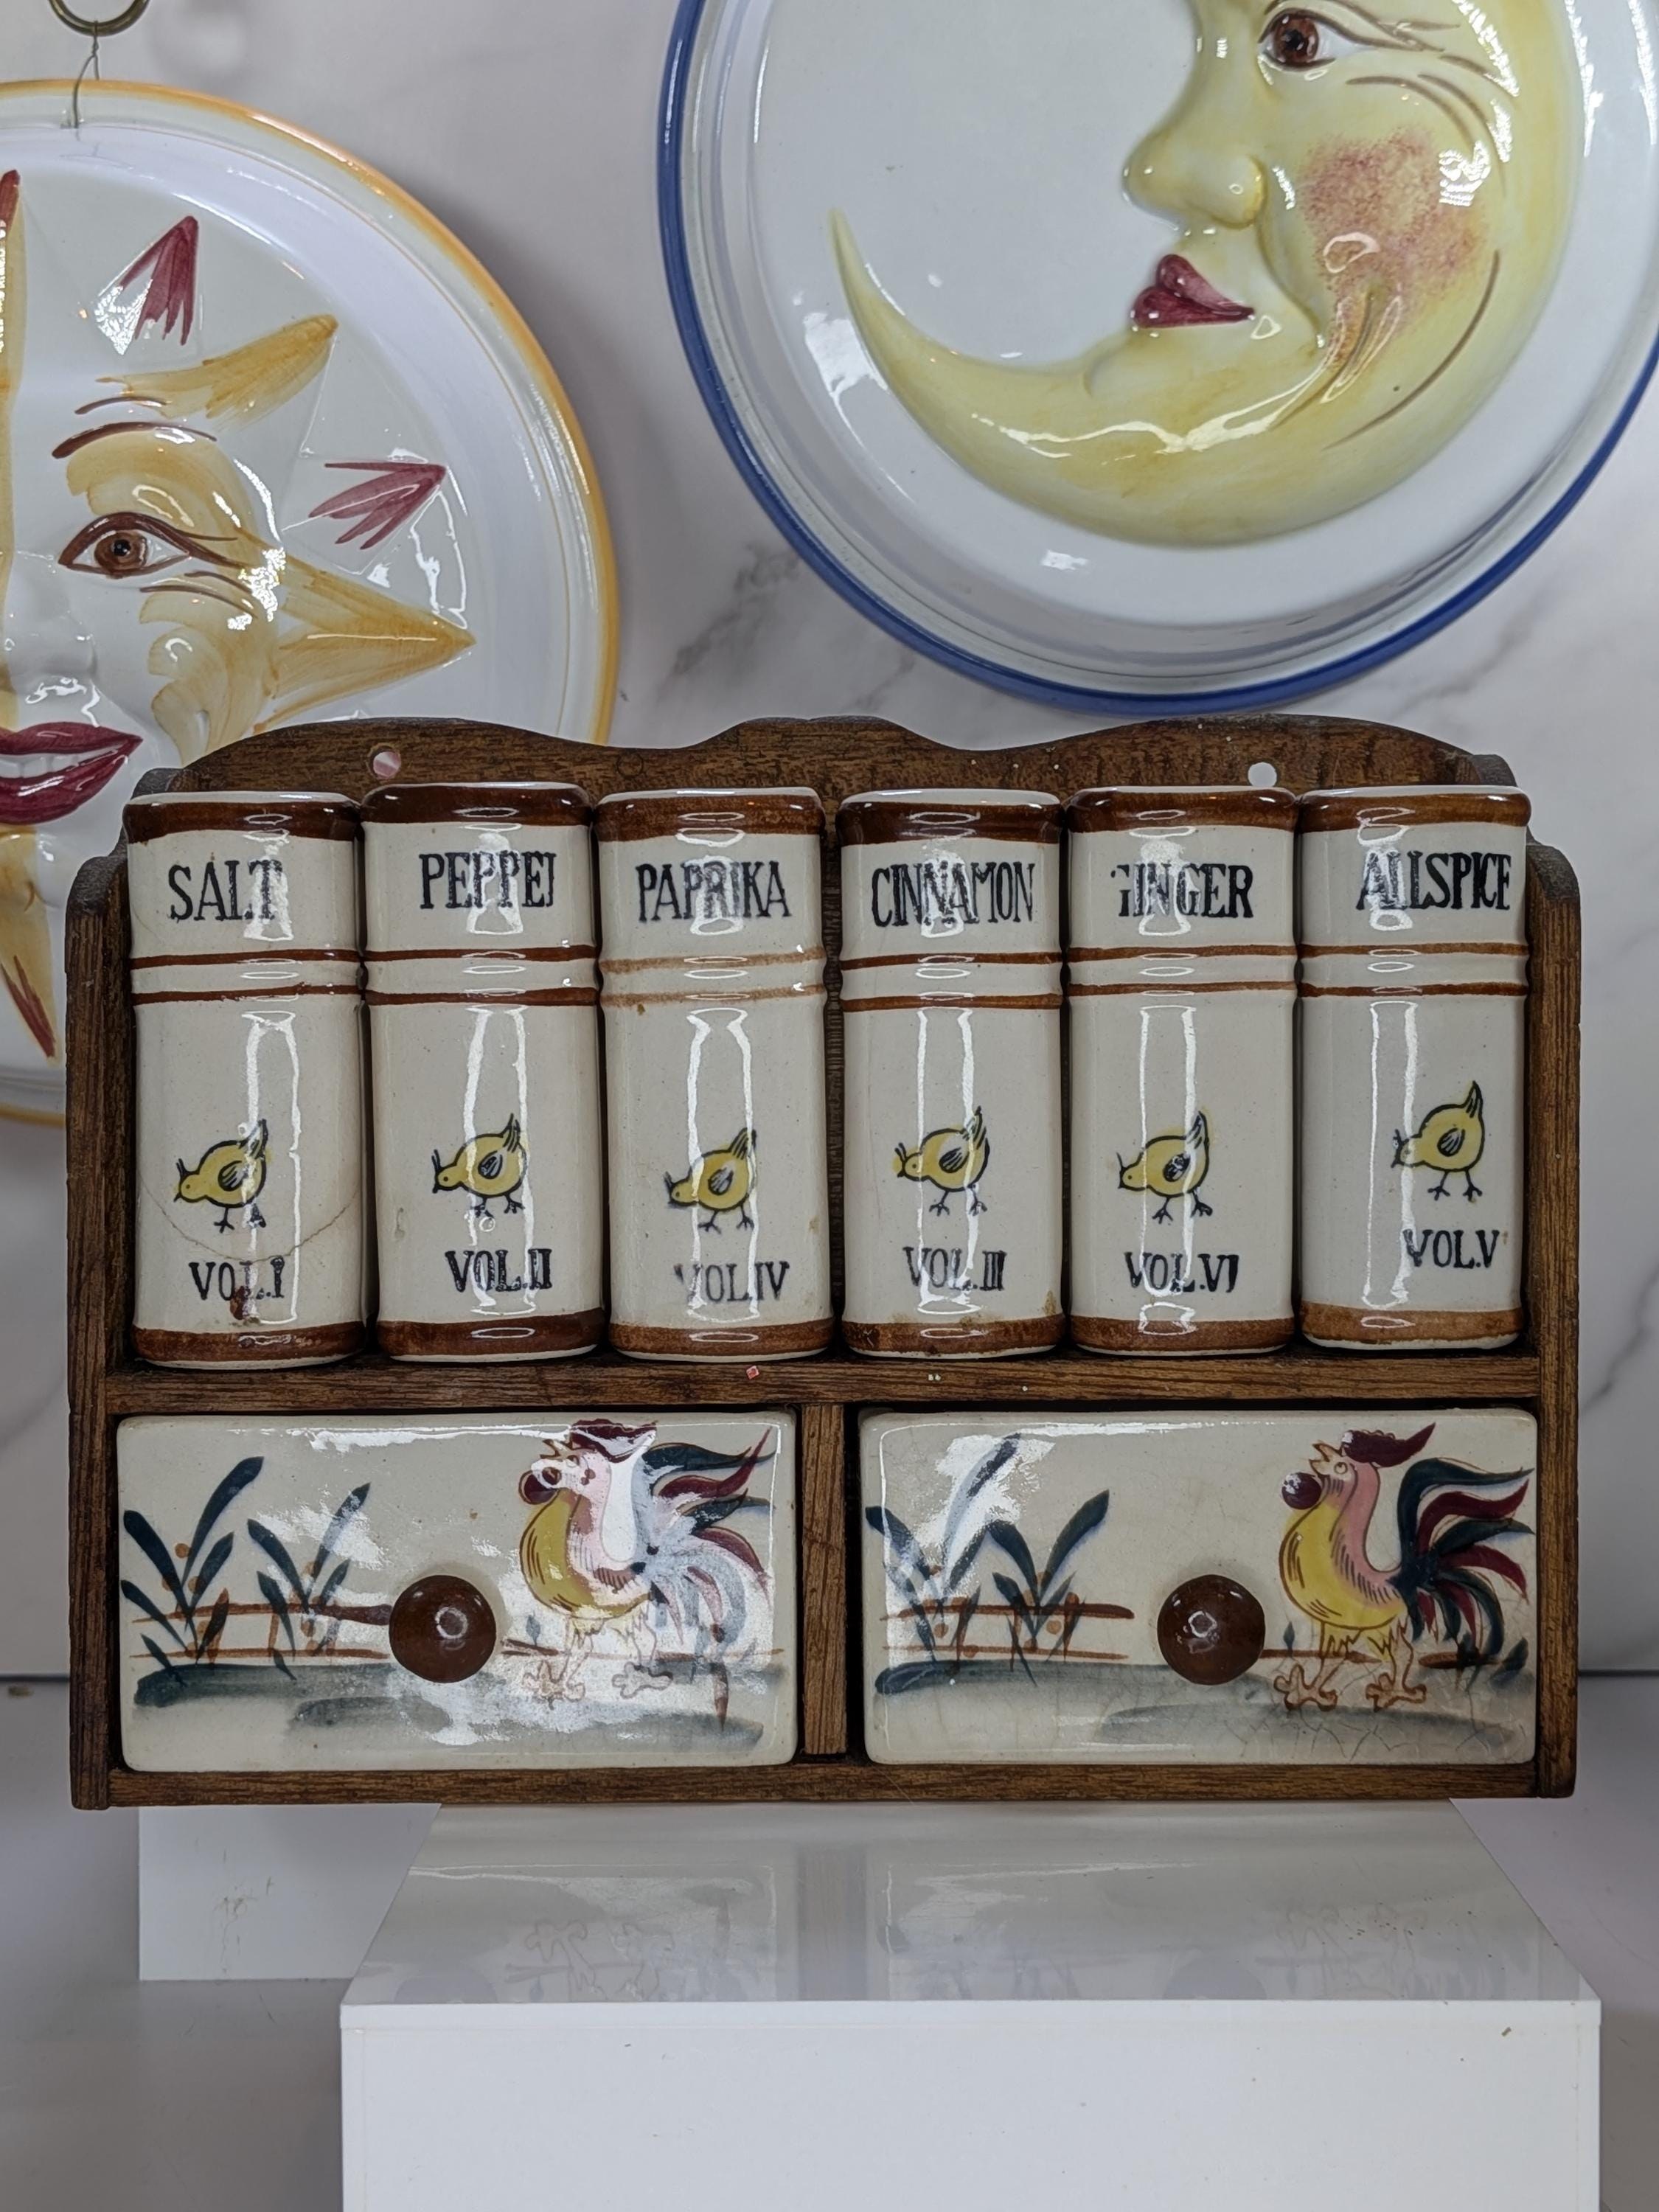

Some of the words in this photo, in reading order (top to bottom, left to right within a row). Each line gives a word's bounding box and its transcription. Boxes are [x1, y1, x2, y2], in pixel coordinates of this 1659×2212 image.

[168, 860, 283, 922] SALT
[636, 860, 792, 922] PAPRIKA
[872, 860, 1036, 927] CINNAMON
[1355, 850, 1512, 911] ALLSPICE
